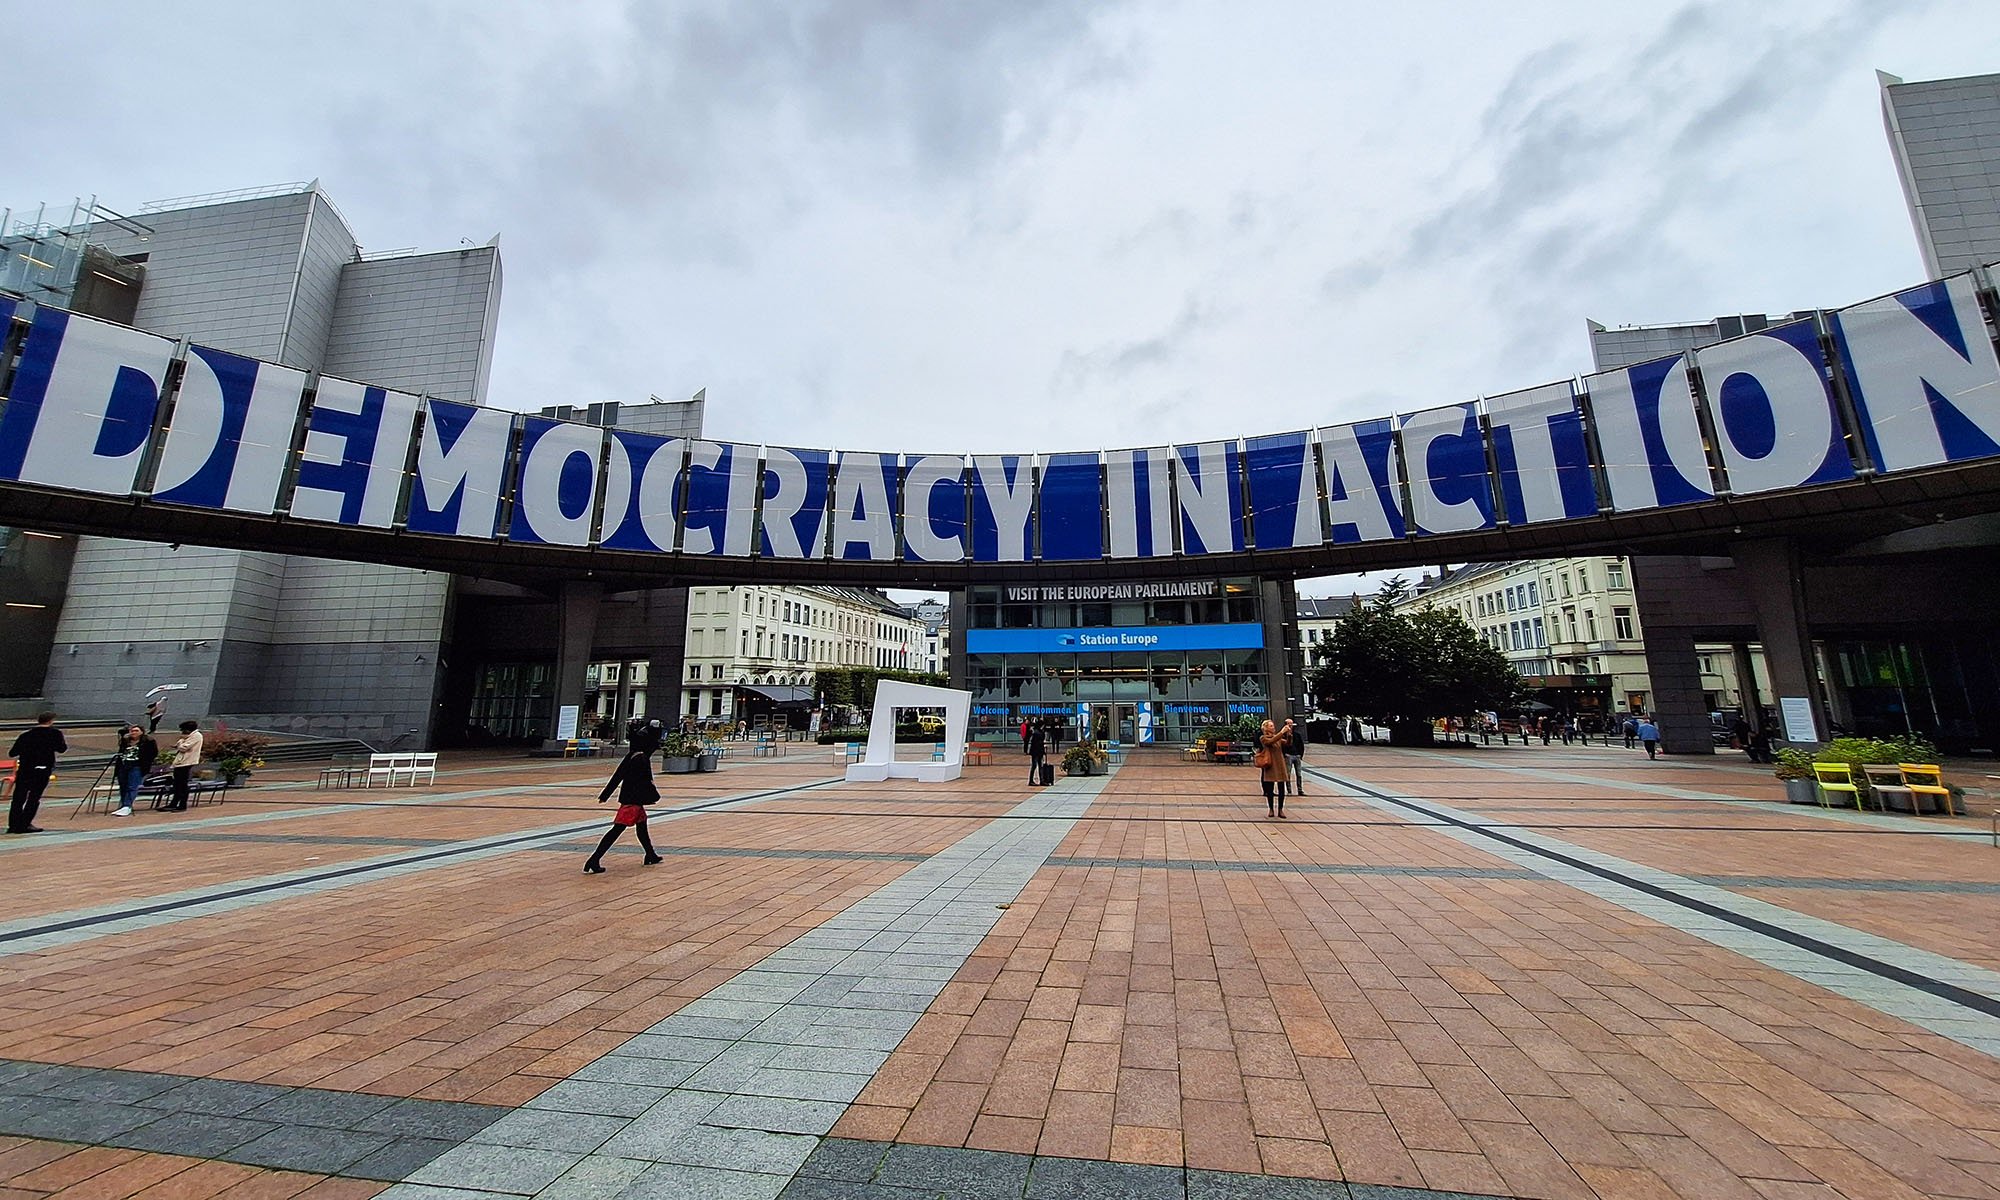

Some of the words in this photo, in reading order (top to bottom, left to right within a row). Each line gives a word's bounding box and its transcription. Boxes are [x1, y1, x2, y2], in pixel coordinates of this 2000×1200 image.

[18, 314, 1050, 562] DEMOCRACY
[1106, 442, 1234, 558] IN
[1292, 262, 2000, 547] ACTION
[1008, 587, 1038, 600] VISIT
[1042, 586, 1064, 600] THE
[1067, 585, 1131, 600] EUROPEAN
[1135, 581, 1214, 598] PARLIAMENT
[1080, 634, 1118, 645] Station
[1121, 633, 1158, 646] Europe
[973, 705, 1009, 715] Welcome
[1020, 705, 1072, 715] Willkommen
[1164, 703, 1210, 713] Bienvenue
[1229, 703, 1265, 713] Welkom
